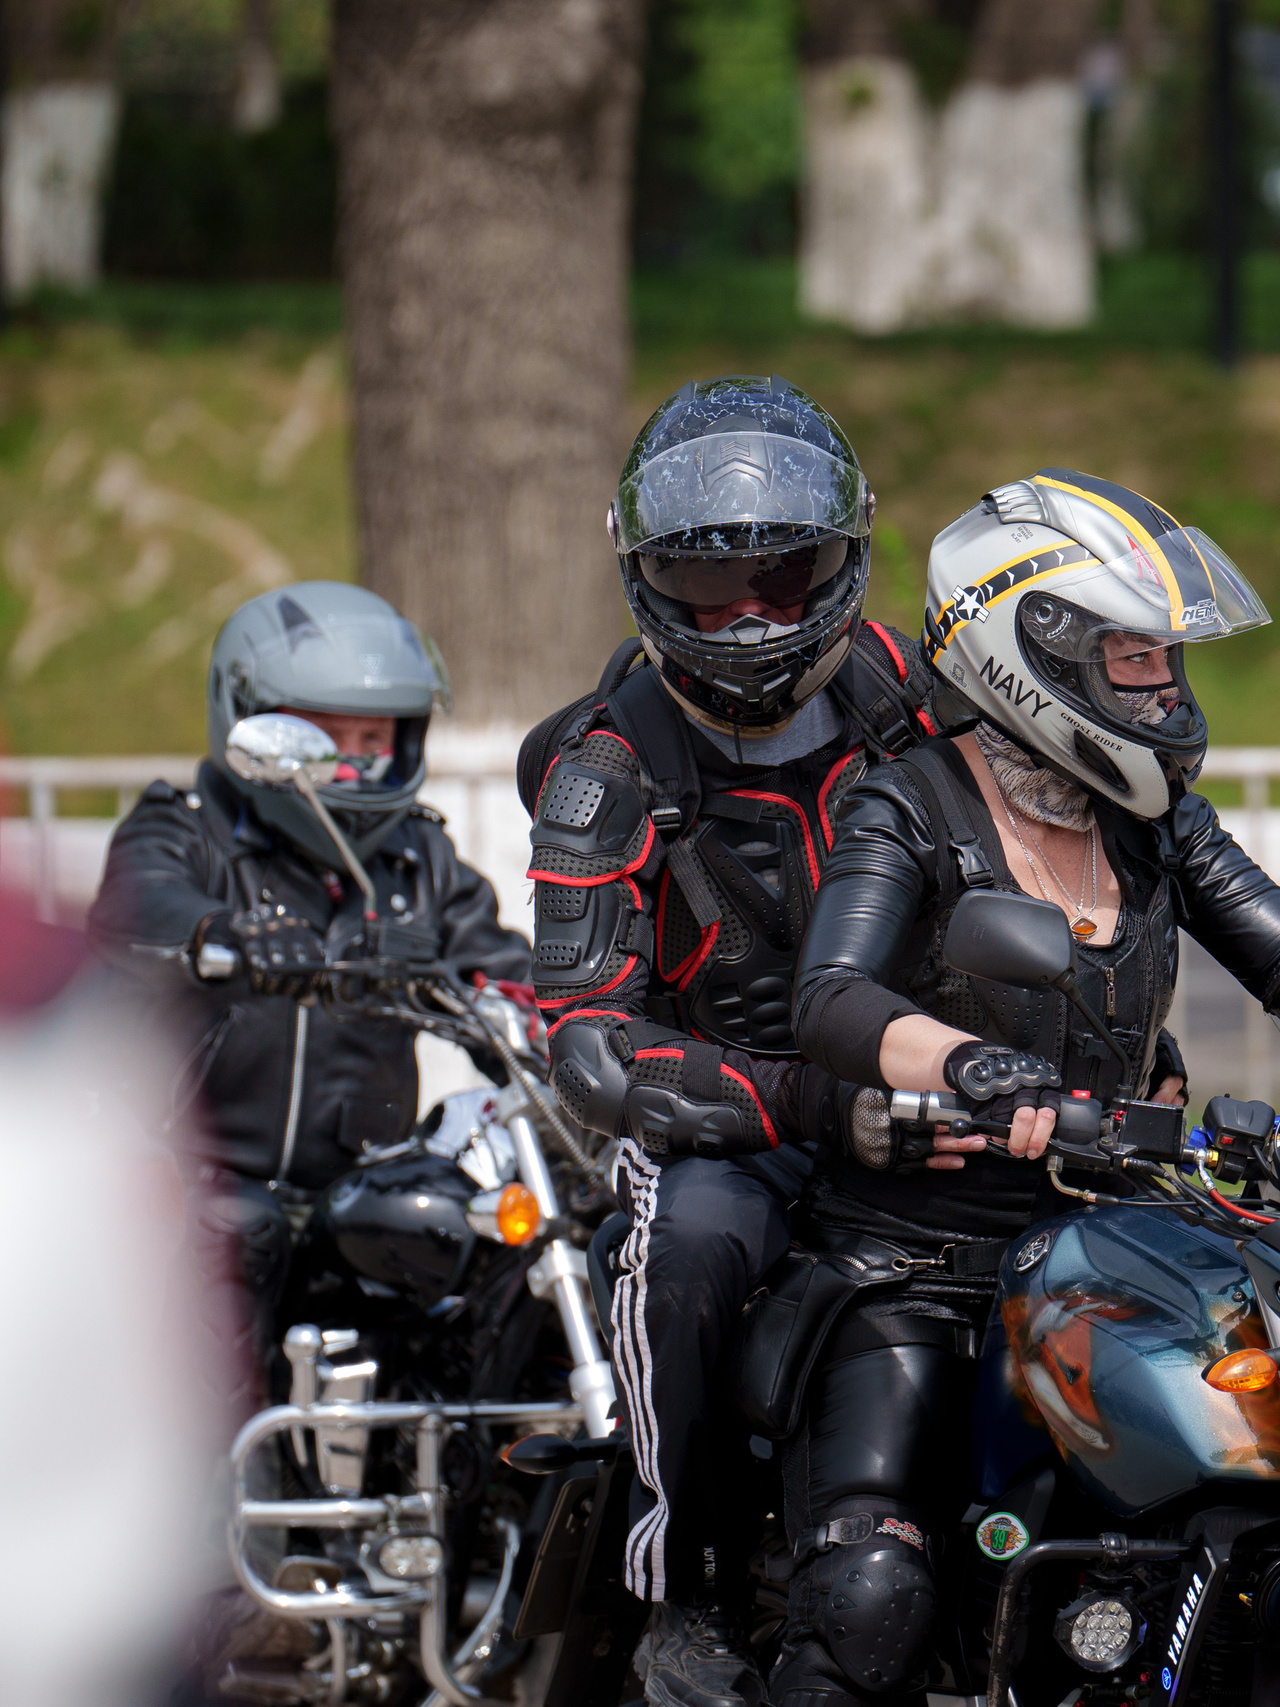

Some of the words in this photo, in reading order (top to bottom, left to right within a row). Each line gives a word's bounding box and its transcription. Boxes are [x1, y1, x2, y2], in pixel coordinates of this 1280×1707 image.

[979, 655, 1053, 718] NAVY
[1060, 711, 1092, 735] GHOST
[1093, 733, 1123, 752] RIDER
[991, 1529, 1006, 1550] 39
[1167, 1573, 1204, 1665] YAMAHA
